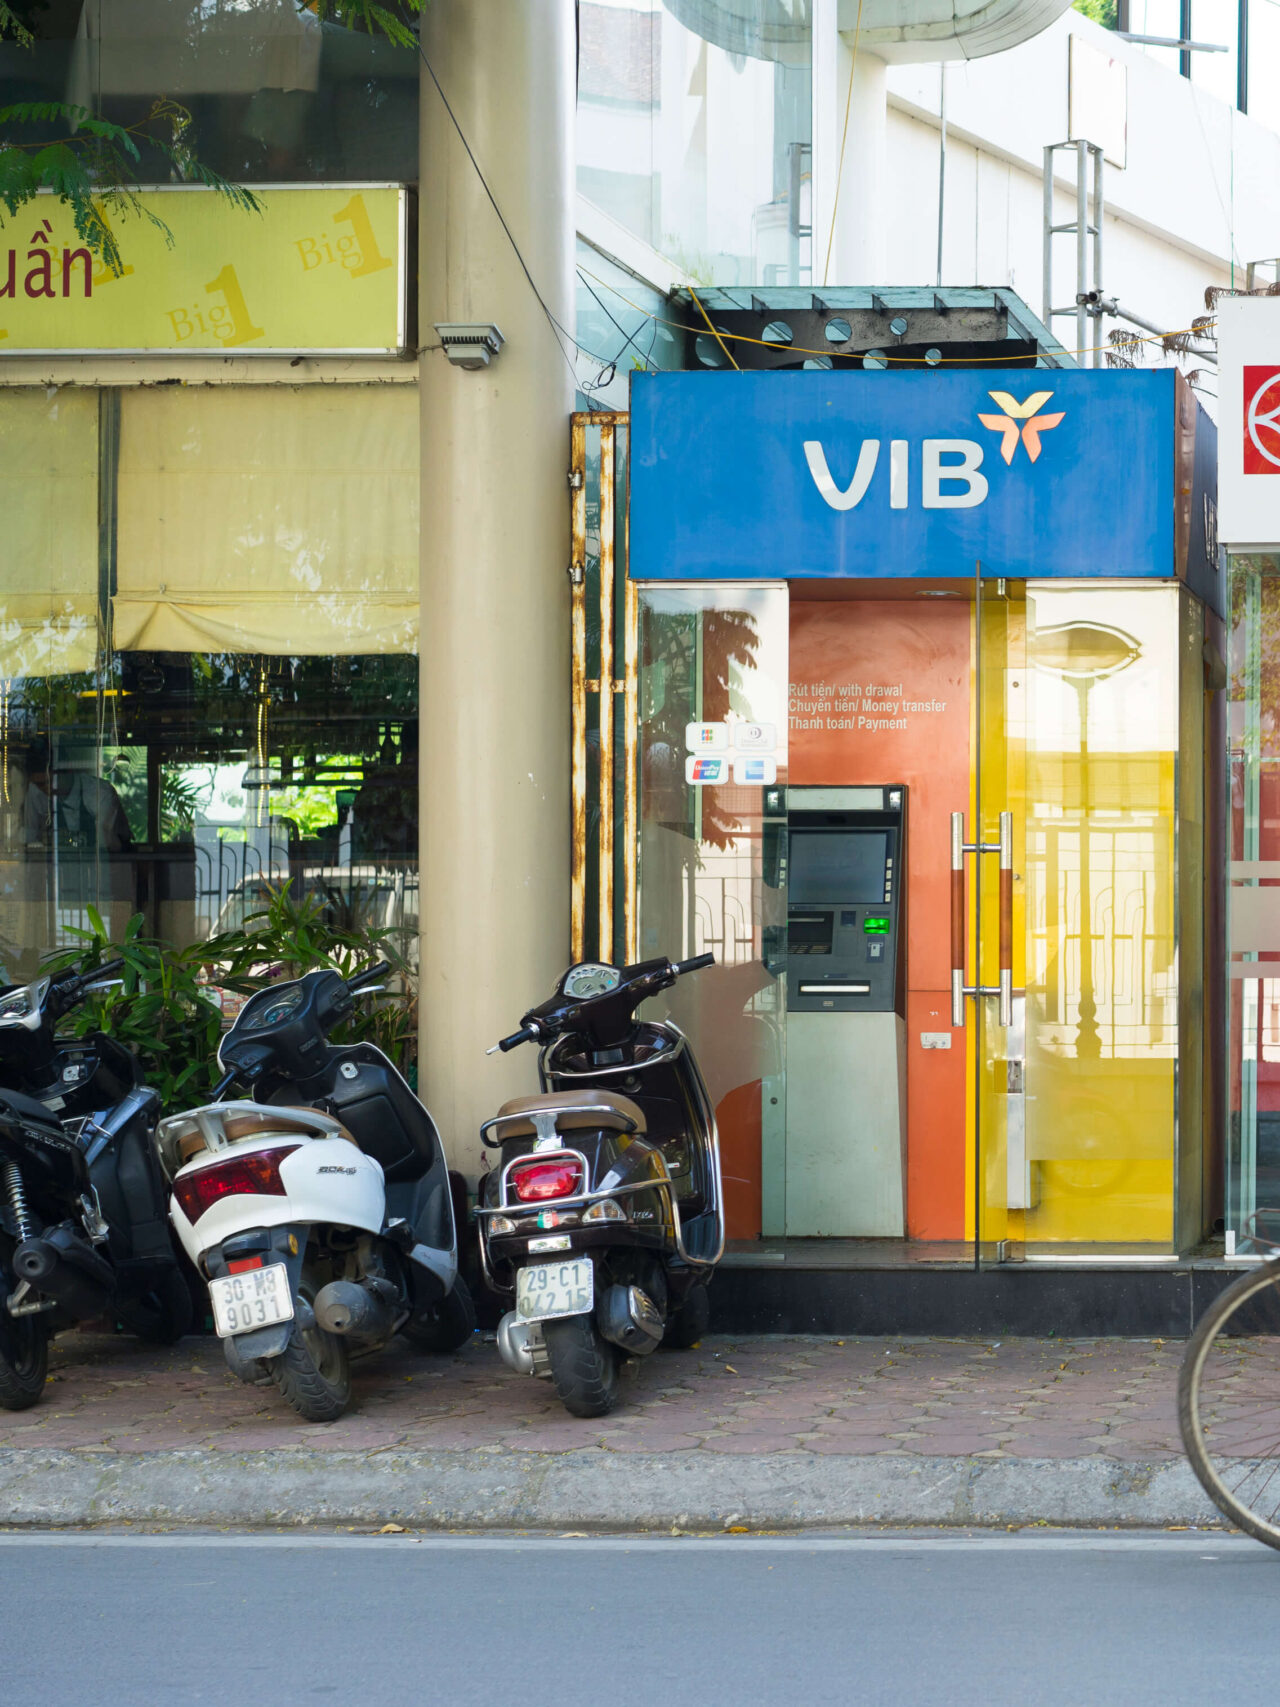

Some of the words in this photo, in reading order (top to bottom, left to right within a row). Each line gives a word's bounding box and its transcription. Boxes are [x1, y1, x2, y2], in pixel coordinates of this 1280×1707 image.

[803, 439, 989, 511] VIB
[788, 683, 808, 697] Rút
[838, 683, 862, 697] with
[865, 683, 903, 697] drawal
[788, 696, 831, 716] Chuyển
[862, 699, 900, 716] Money
[902, 698, 947, 713] transfer
[788, 716, 824, 730] Thanh
[826, 716, 855, 730] toán/
[857, 716, 908, 733] Payment
[526, 1264, 580, 1293] 29-C1
[227, 1296, 281, 1330] 9031
